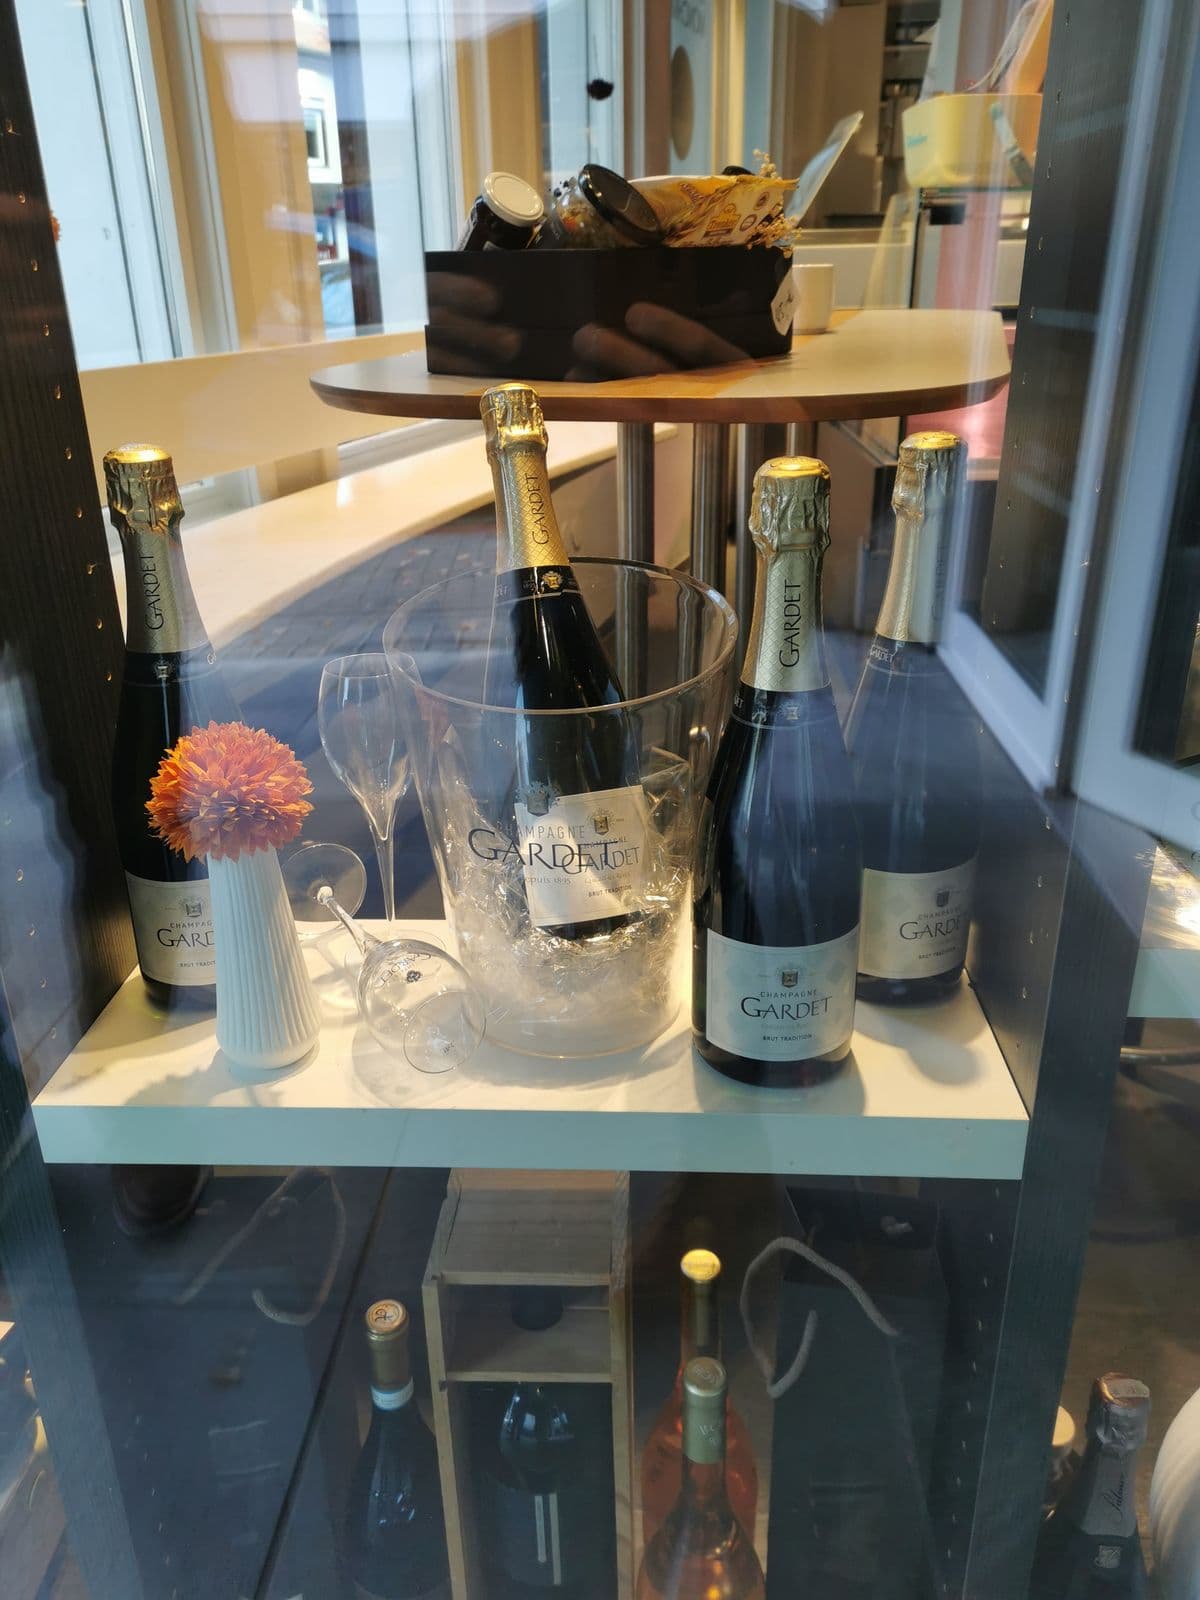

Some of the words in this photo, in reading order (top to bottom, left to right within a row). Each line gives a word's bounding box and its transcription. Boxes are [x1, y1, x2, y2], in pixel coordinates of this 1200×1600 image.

[525, 472, 550, 545] GARDET
[140, 556, 164, 630] GARDET
[779, 579, 802, 668] GARDET
[468, 827, 619, 870] GARDET
[741, 996, 832, 1020] GARDET
[759, 989, 817, 998] CHAMPAGNE
